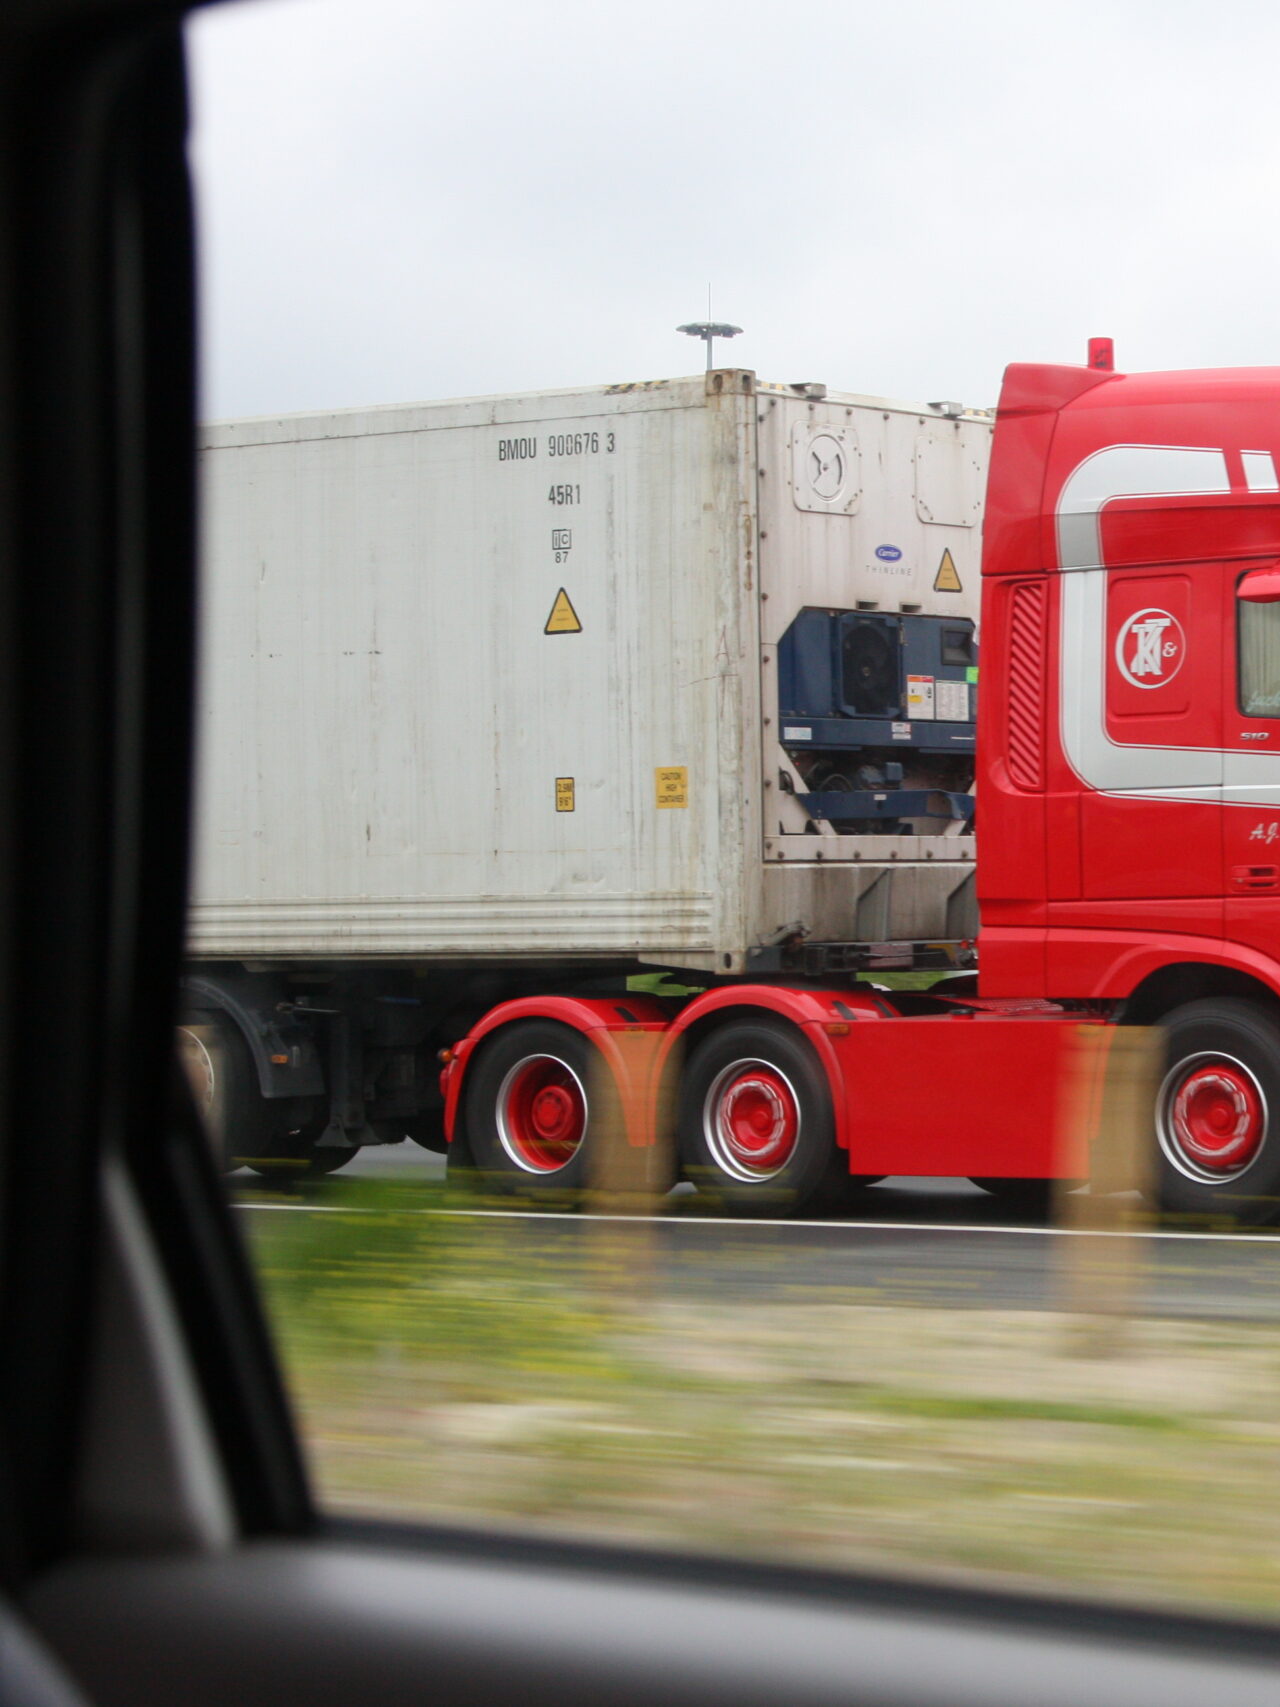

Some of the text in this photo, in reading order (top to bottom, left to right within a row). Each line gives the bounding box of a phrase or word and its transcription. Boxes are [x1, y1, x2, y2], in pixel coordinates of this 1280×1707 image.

[498, 432, 616, 462] BMOU 900676 3
[547, 484, 582, 506] 45R1
[554, 551, 570, 564] 87
[1240, 732, 1270, 741] 510
